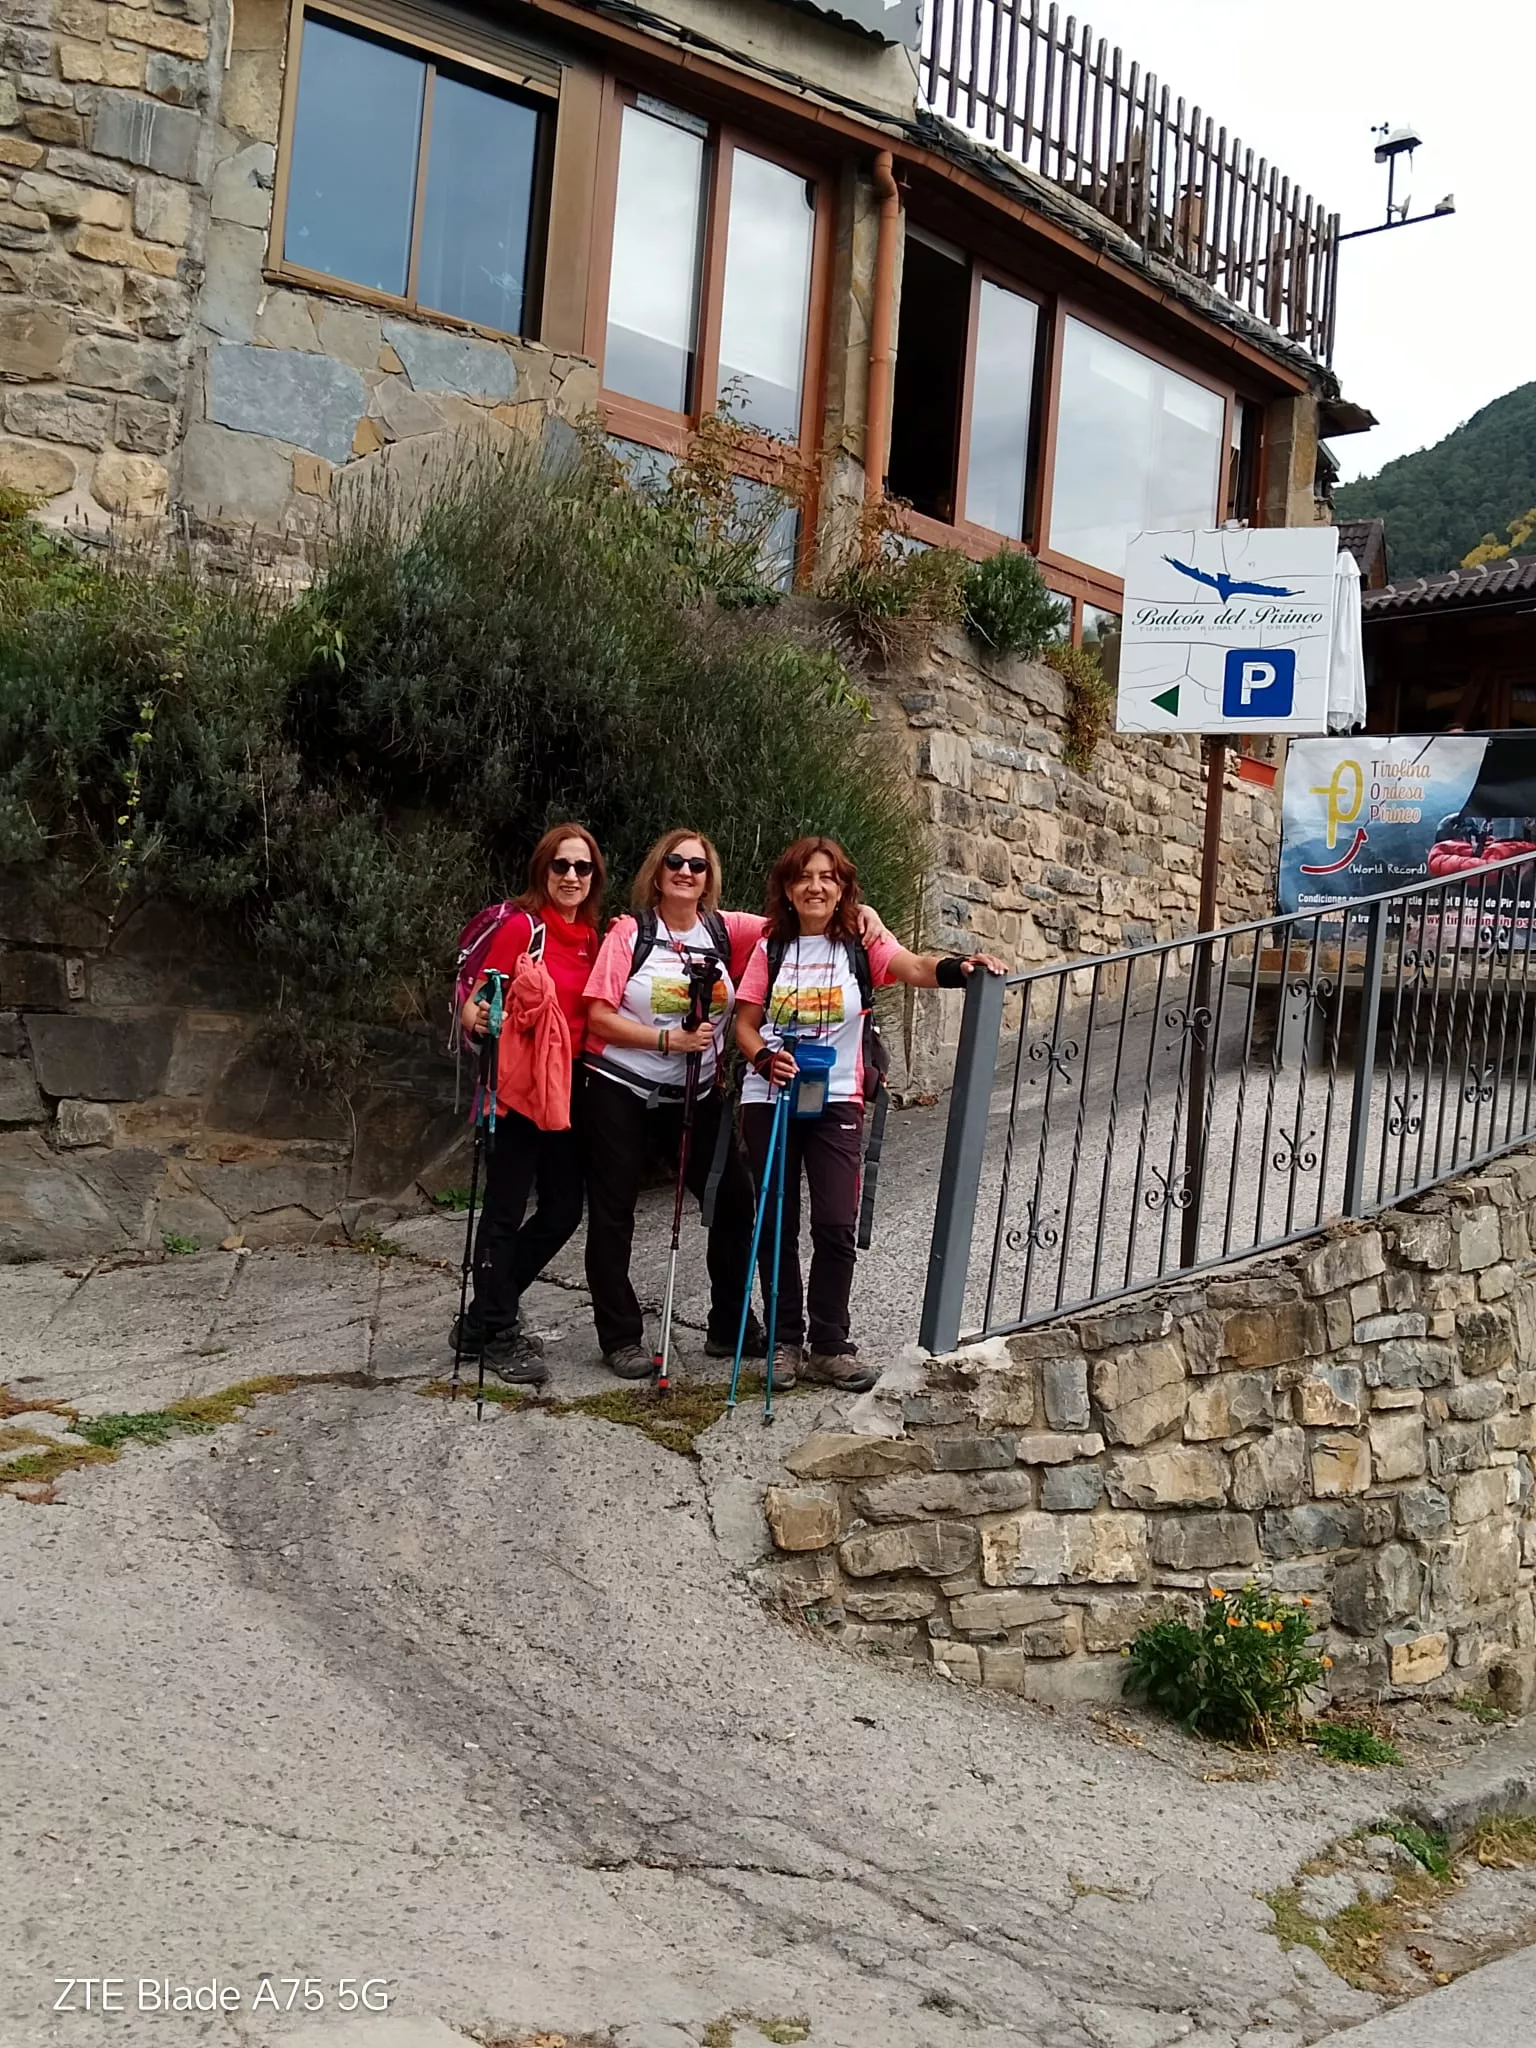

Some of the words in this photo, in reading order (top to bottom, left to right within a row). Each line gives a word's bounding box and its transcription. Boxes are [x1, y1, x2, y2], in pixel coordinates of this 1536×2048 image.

[1132, 607, 1205, 625] Balcón
[1214, 608, 1247, 625] del
[1249, 605, 1323, 624] Pirineo
[1240, 662, 1276, 705] P
[1370, 760, 1432, 778] Tirolina
[1370, 782, 1424, 800] Ordesa
[1370, 804, 1421, 823] Pirineo
[1348, 863, 1383, 875] (World
[1387, 862, 1427, 875] Record)
